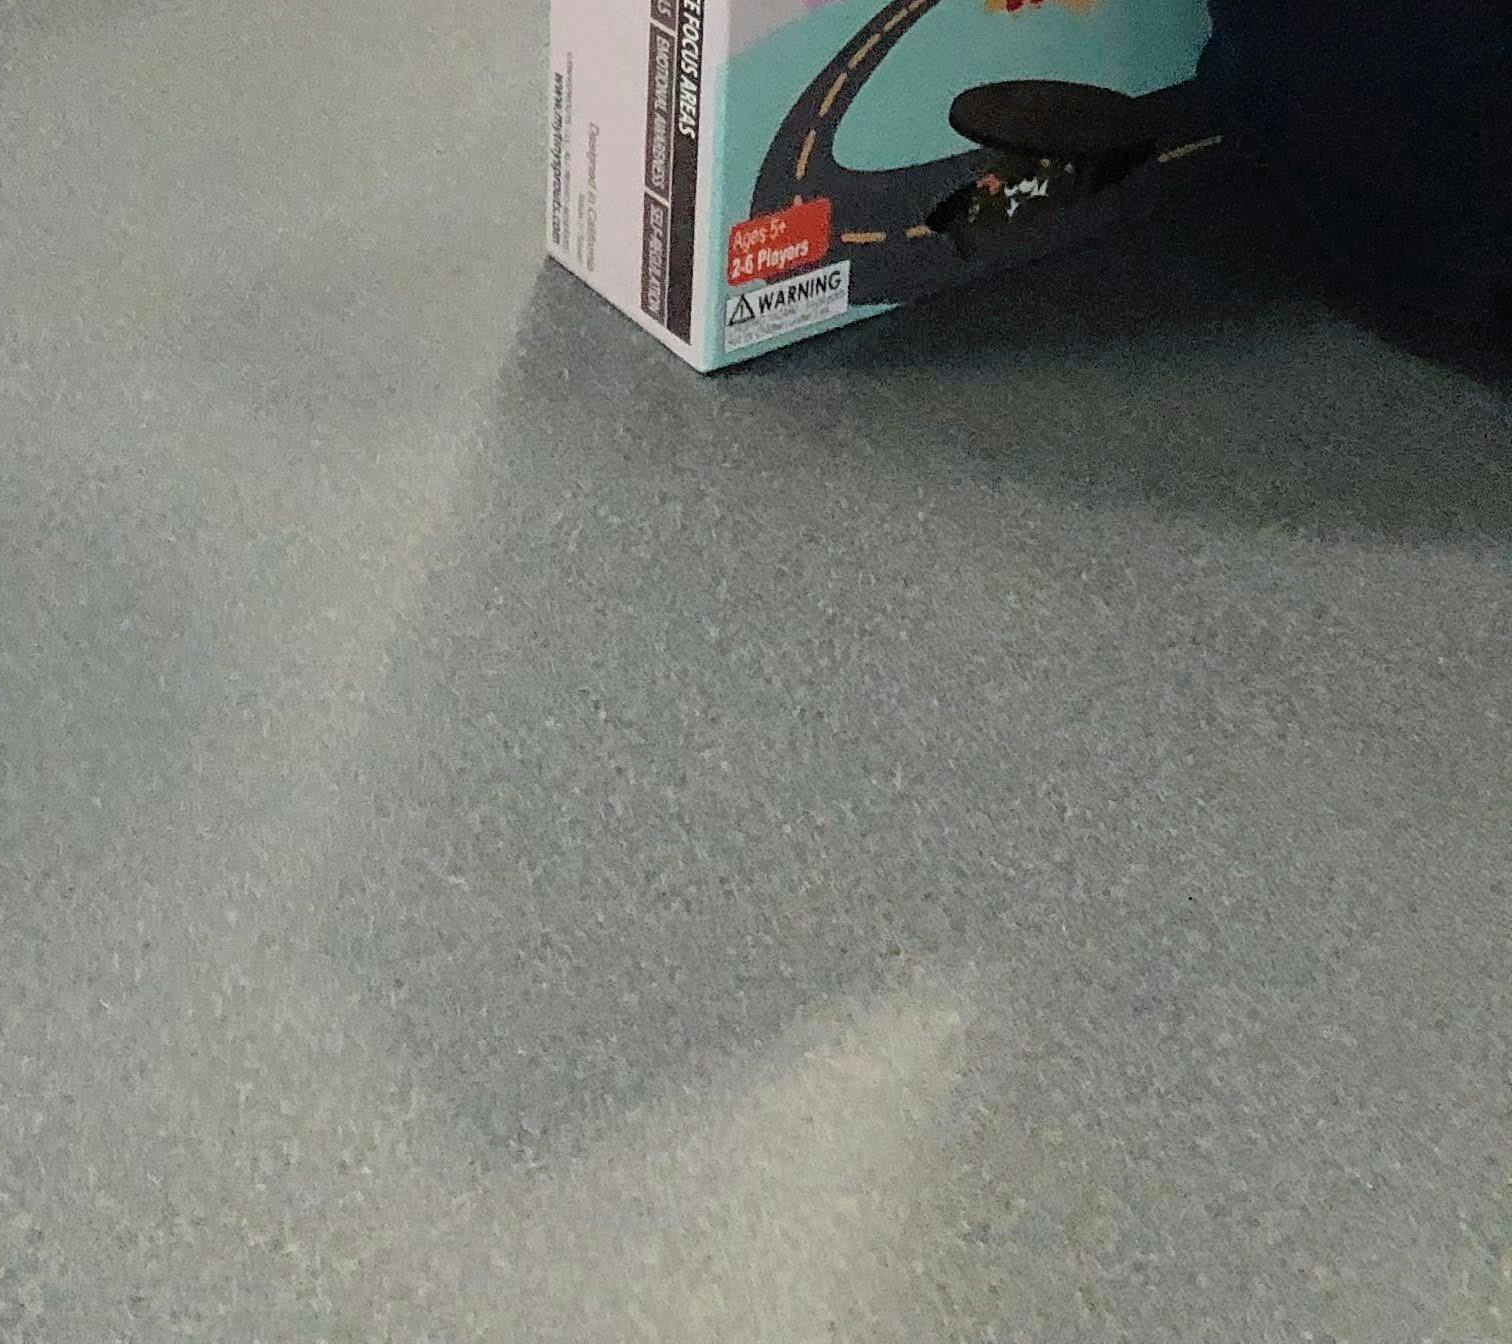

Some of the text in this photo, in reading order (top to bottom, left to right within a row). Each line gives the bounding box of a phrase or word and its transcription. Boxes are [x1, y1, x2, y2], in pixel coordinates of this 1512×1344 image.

[681, 15, 700, 77] FOCUS
[651, 35, 669, 190] EMOTIONAL AWARENESS
[678, 75, 697, 139] AREAS
[551, 71, 564, 243] www.mytinysprouts.com
[586, 121, 600, 272] Designed in California
[647, 203, 664, 313] SELF-REGULATION
[731, 239, 810, 280] 2-6 Players
[732, 217, 787, 254] Ages 5+
[758, 270, 842, 314] WARNING
